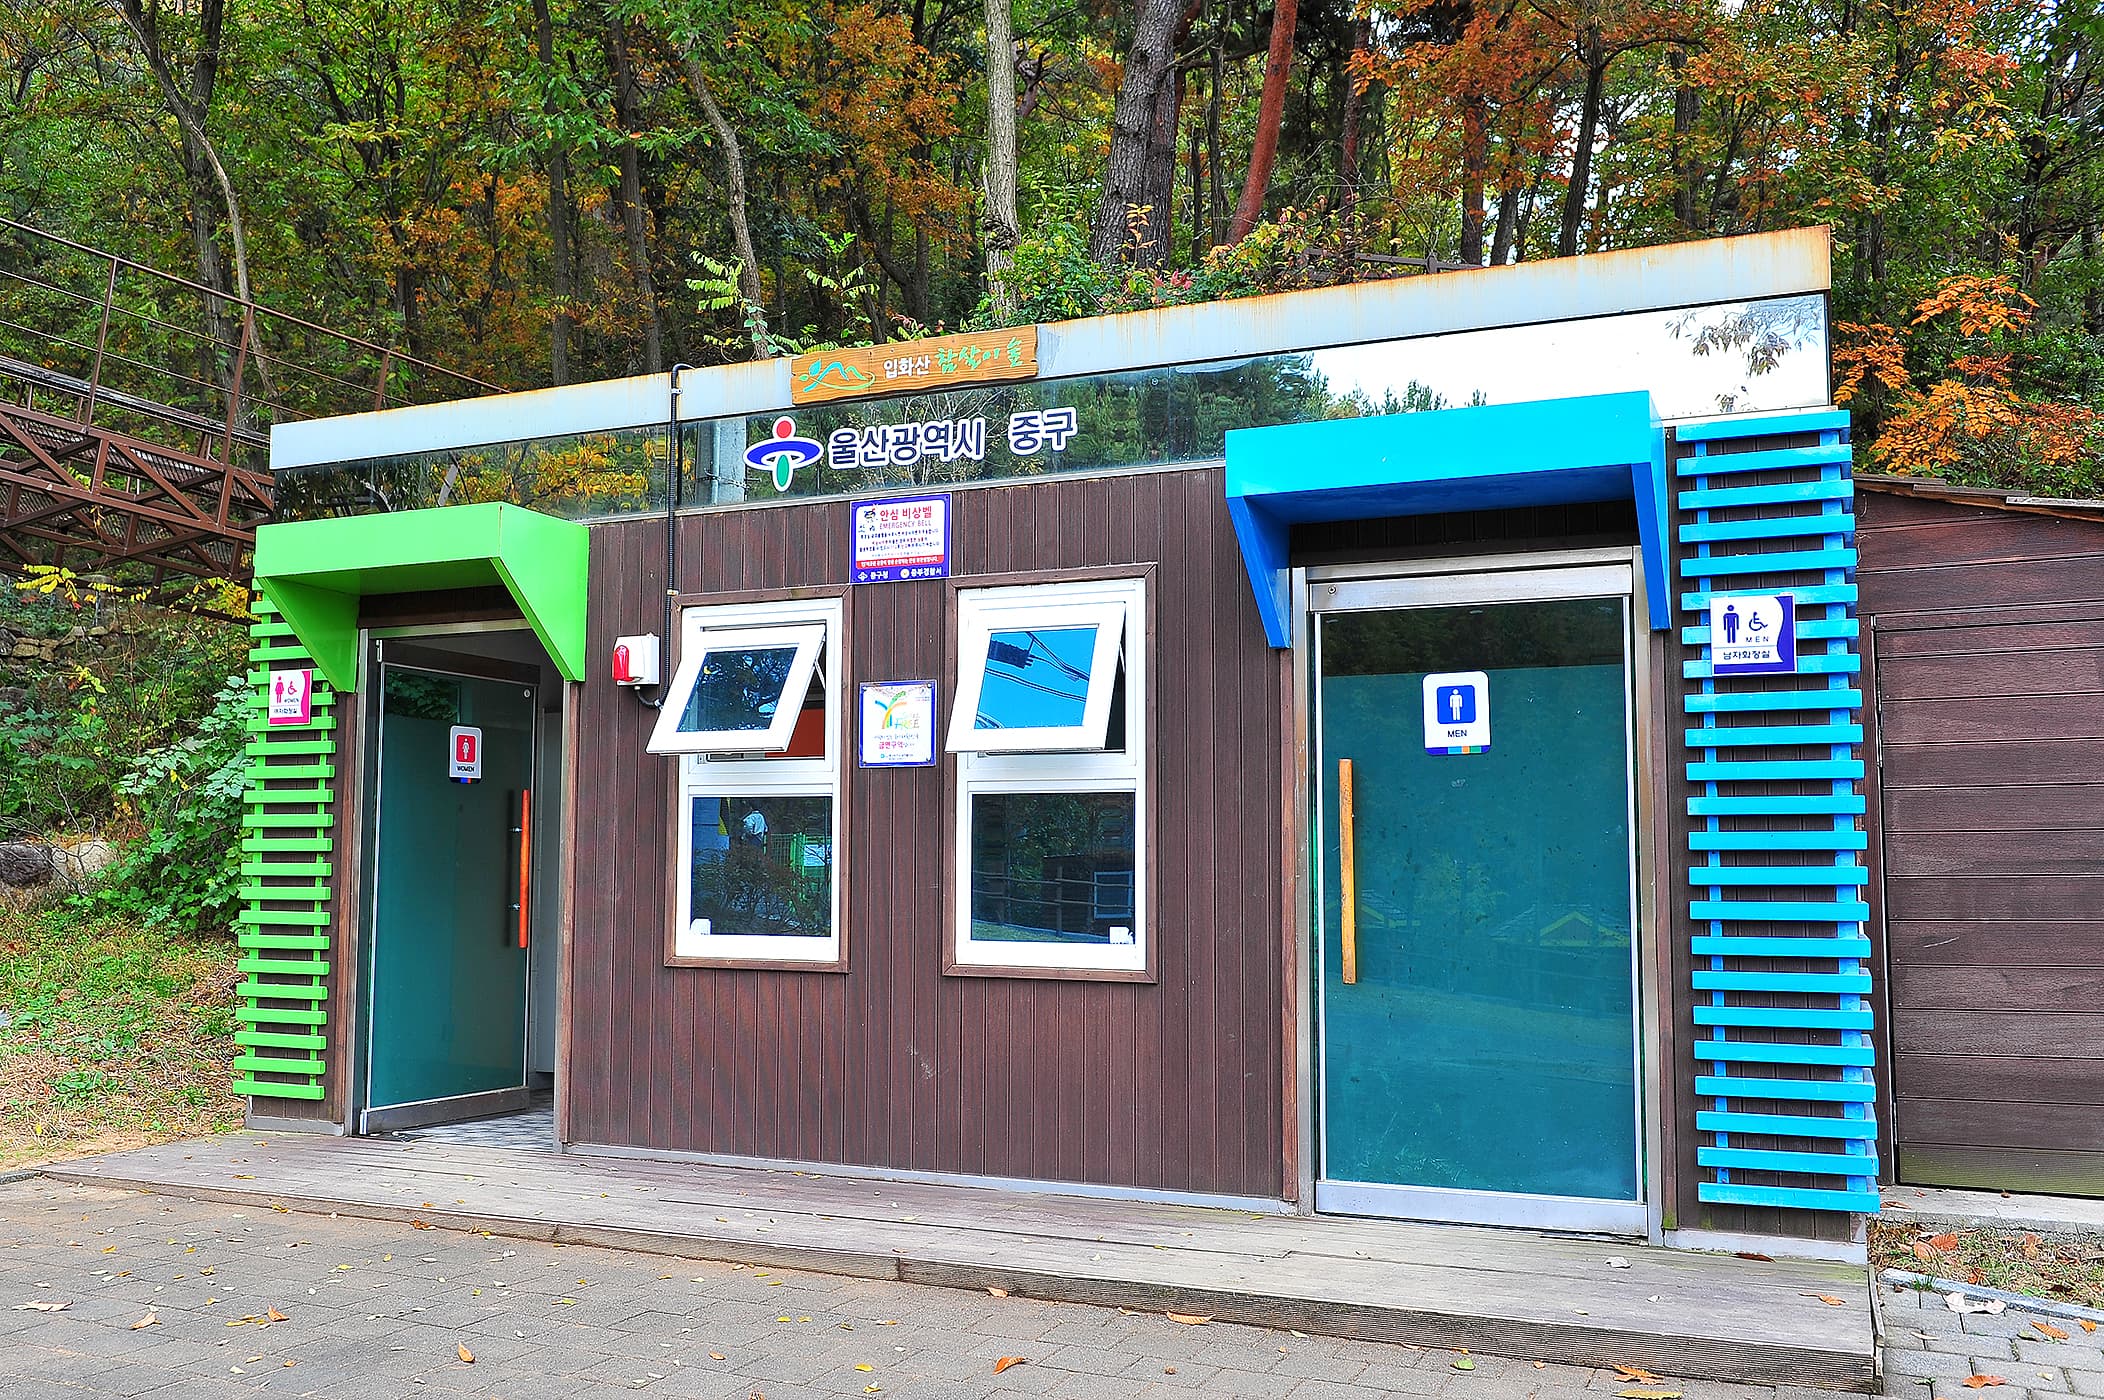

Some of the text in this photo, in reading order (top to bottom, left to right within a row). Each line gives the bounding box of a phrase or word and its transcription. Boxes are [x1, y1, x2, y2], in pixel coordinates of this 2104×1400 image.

[884, 336, 1024, 378] 입화산 참살이 숲
[829, 408, 1076, 467] 울산광역시 중구
[880, 506, 932, 521] 안심 비상벨
[879, 520, 915, 530] EMERGENCY
[1723, 650, 1770, 660] 남자화장실
[1447, 729, 1468, 738] MEN
[456, 765, 475, 773] WOMEN
